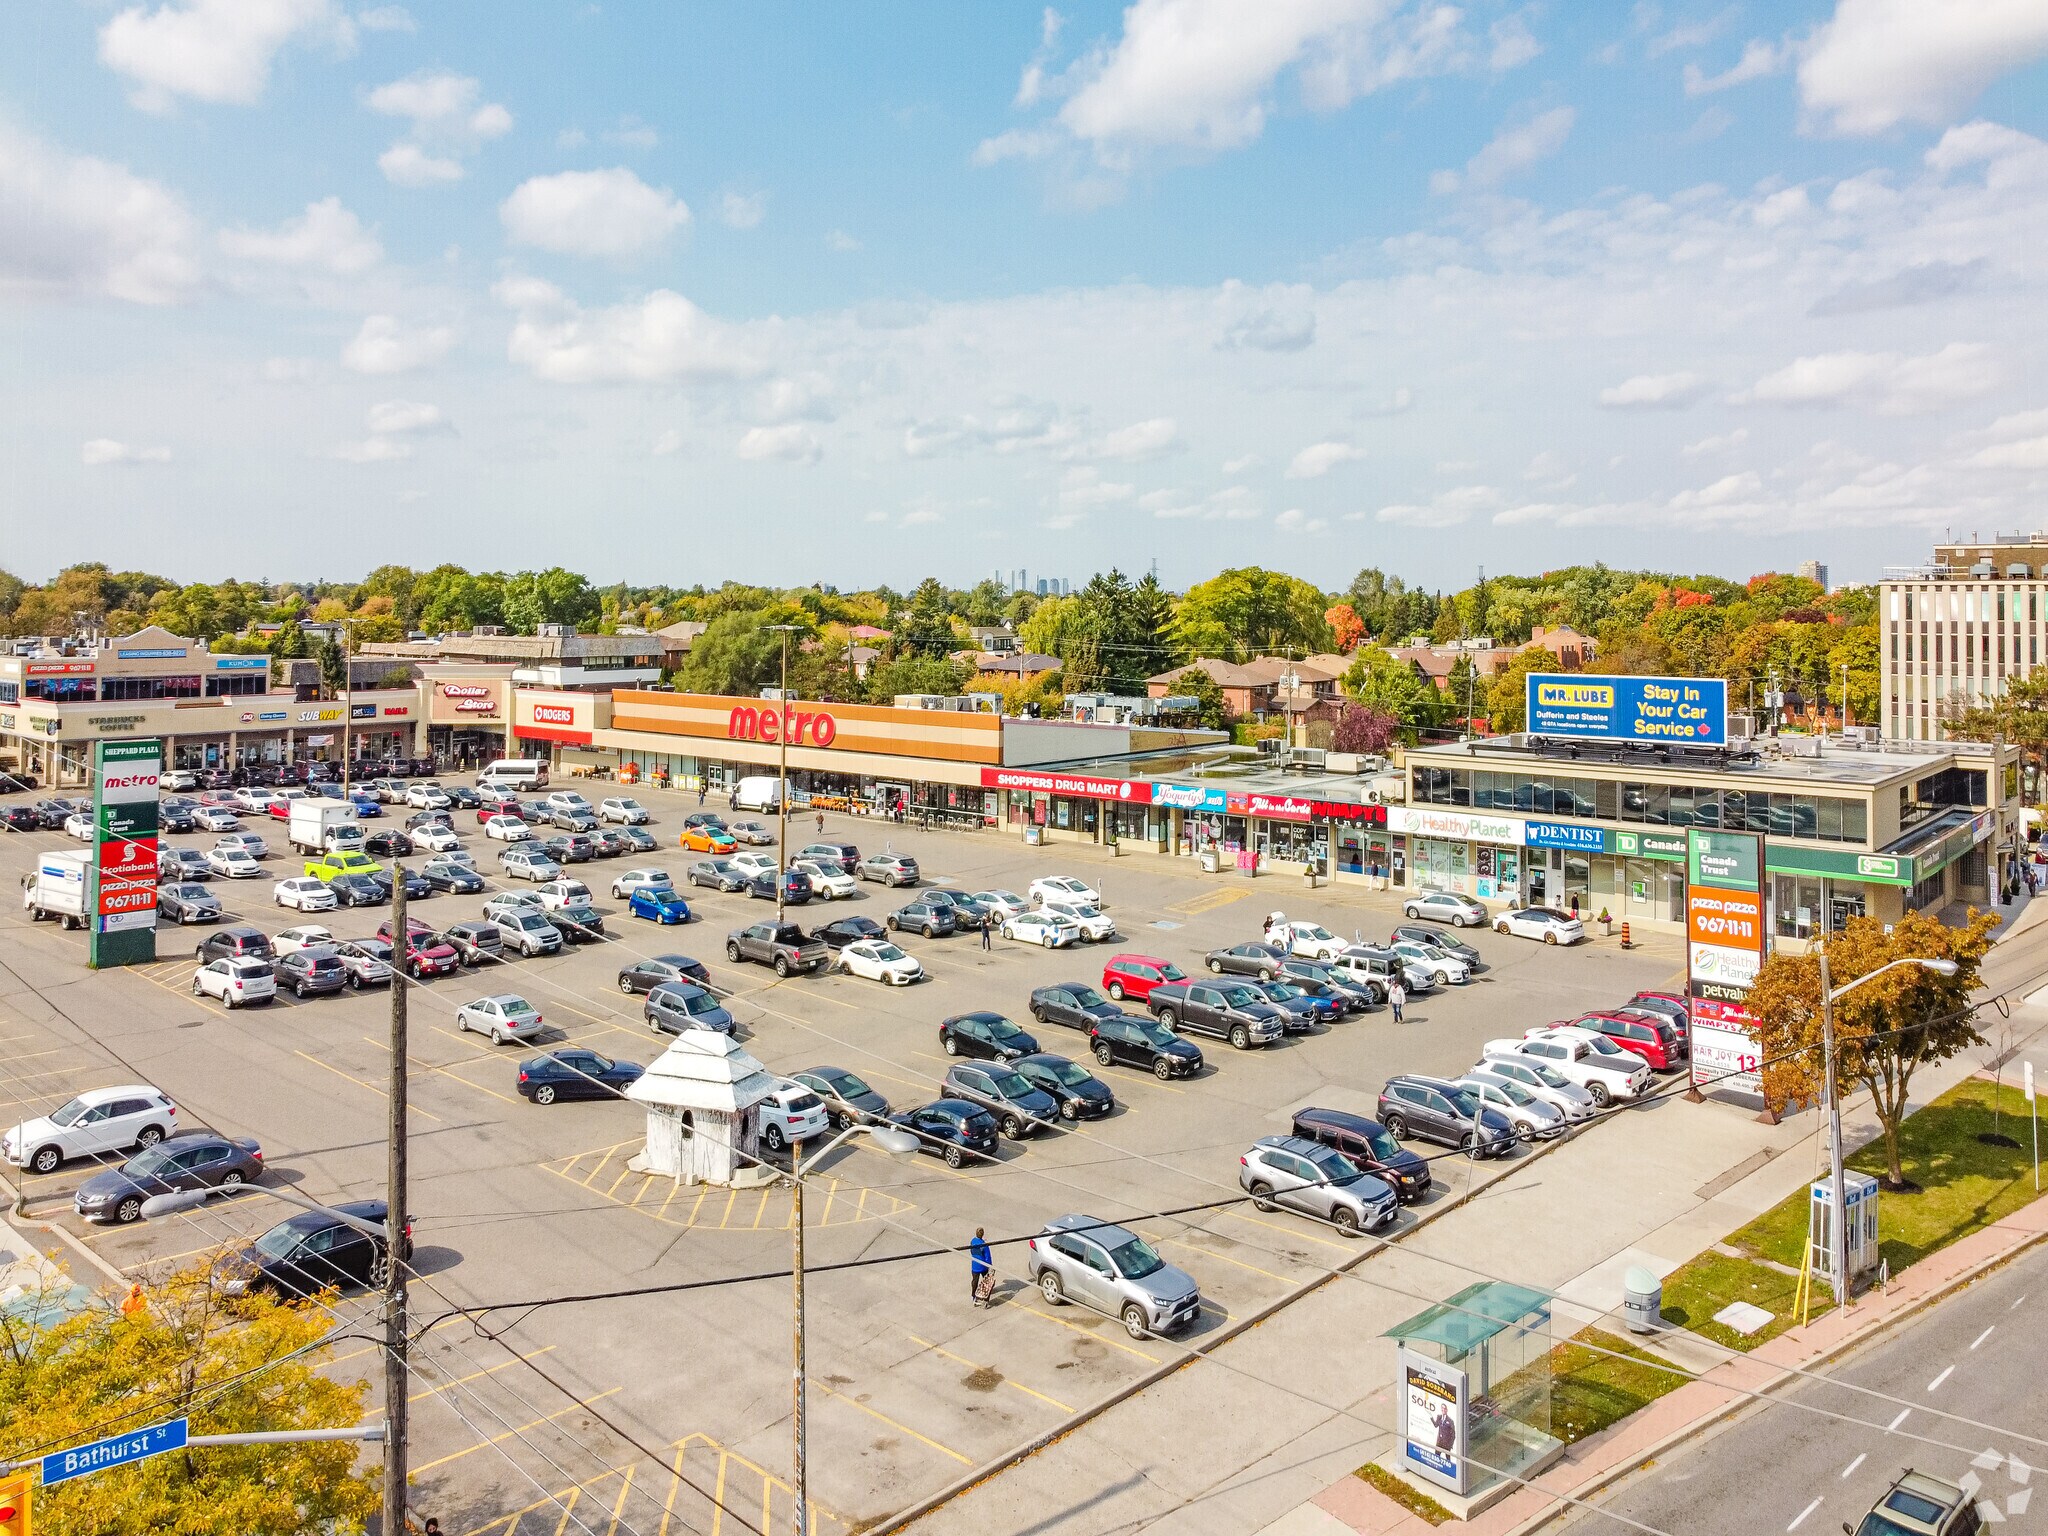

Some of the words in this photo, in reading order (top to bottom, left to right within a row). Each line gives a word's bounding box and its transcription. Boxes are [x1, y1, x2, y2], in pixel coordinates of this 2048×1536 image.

[444, 684, 489, 697] Dollar
[1543, 688, 1570, 702] MR.
[1574, 689, 1608, 704] LUBE
[1643, 684, 1680, 701] Stay
[1684, 686, 1700, 701] In
[456, 698, 496, 711] Store
[1637, 701, 1673, 718] Your
[1677, 704, 1708, 720] Car
[88, 716, 146, 724] STARBUCKS
[298, 709, 344, 721] SUBWAY
[543, 708, 571, 722] ROGERS
[1536, 710, 1564, 719] Dufferin
[728, 702, 836, 747] metro
[1634, 719, 1695, 737] Service
[104, 747, 138, 756] SHEPPARD
[139, 746, 159, 754] PLAZA
[105, 774, 158, 788] metro
[997, 773, 1054, 789] SHOPPERS
[1055, 779, 1085, 791] DRUG
[1086, 781, 1118, 795] MART
[1312, 801, 1387, 823] WIMPY'S
[109, 819, 135, 827] Canada
[1292, 826, 1307, 834] COPY
[1539, 825, 1603, 842] DENTIST
[1618, 836, 1636, 850] TD
[1643, 838, 1686, 852] Canada
[102, 862, 155, 874] Scotiabank
[1700, 854, 1738, 867] Canada
[1701, 864, 1729, 876] Trust
[101, 881, 128, 894] pizza
[129, 878, 156, 891] pizza
[1691, 897, 1723, 910] pizza
[1724, 901, 1758, 915] pizza
[1716, 951, 1759, 971] Healthy
[1692, 1017, 1737, 1032] WIMPY'S
[1693, 1045, 1713, 1058] HAIR
[1715, 1050, 1732, 1061] JOY
[1737, 1053, 1757, 1073] 13
[1411, 1394, 1436, 1412] SOLD
[65, 1434, 150, 1474] Bathurst
[156, 1427, 167, 1440] St
